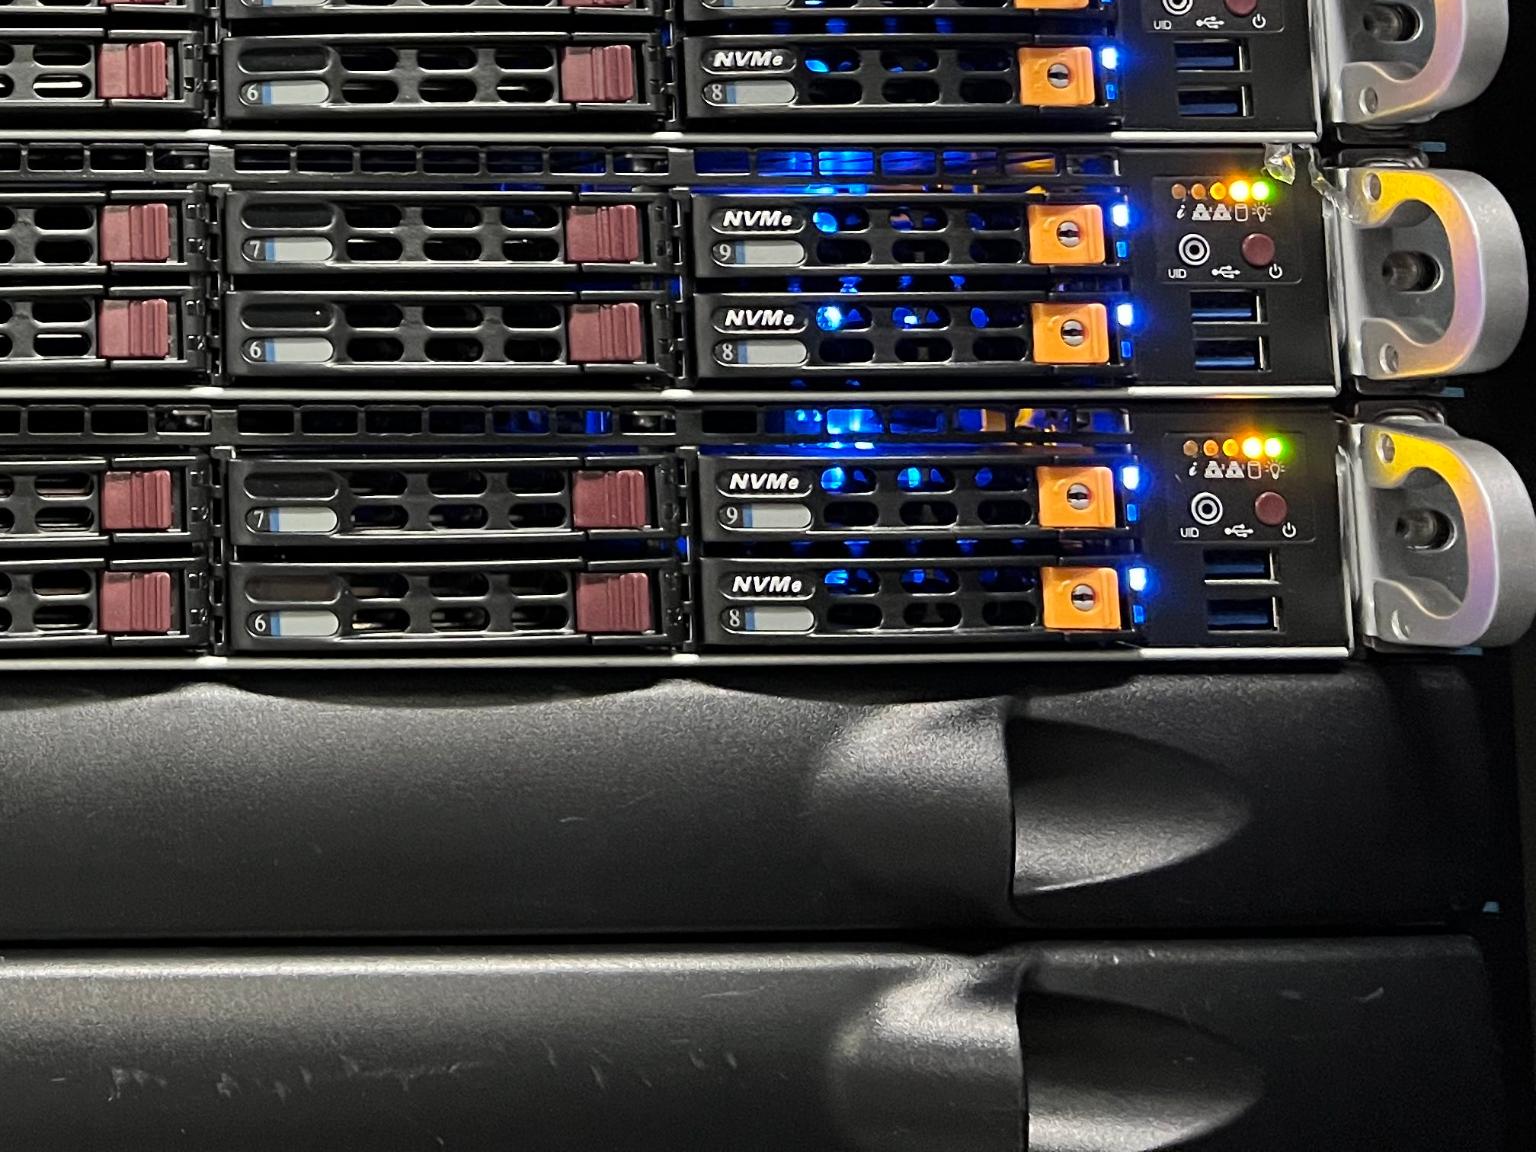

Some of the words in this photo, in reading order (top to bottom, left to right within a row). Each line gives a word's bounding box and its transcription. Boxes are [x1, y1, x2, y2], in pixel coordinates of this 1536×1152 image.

[714, 51, 783, 67] NVMe
[246, 82, 259, 102] 6
[711, 82, 723, 102] 8
[723, 210, 792, 227] NVMe
[248, 239, 261, 259] 7
[718, 242, 732, 262] 9
[724, 309, 795, 326] NVMe
[248, 340, 262, 360] 6
[721, 342, 734, 362] 8
[729, 473, 800, 490] NVMe
[253, 509, 265, 529] 7
[725, 505, 739, 526] 9
[732, 576, 802, 592] NVMe
[253, 613, 267, 633] 6
[728, 607, 741, 628] 8
